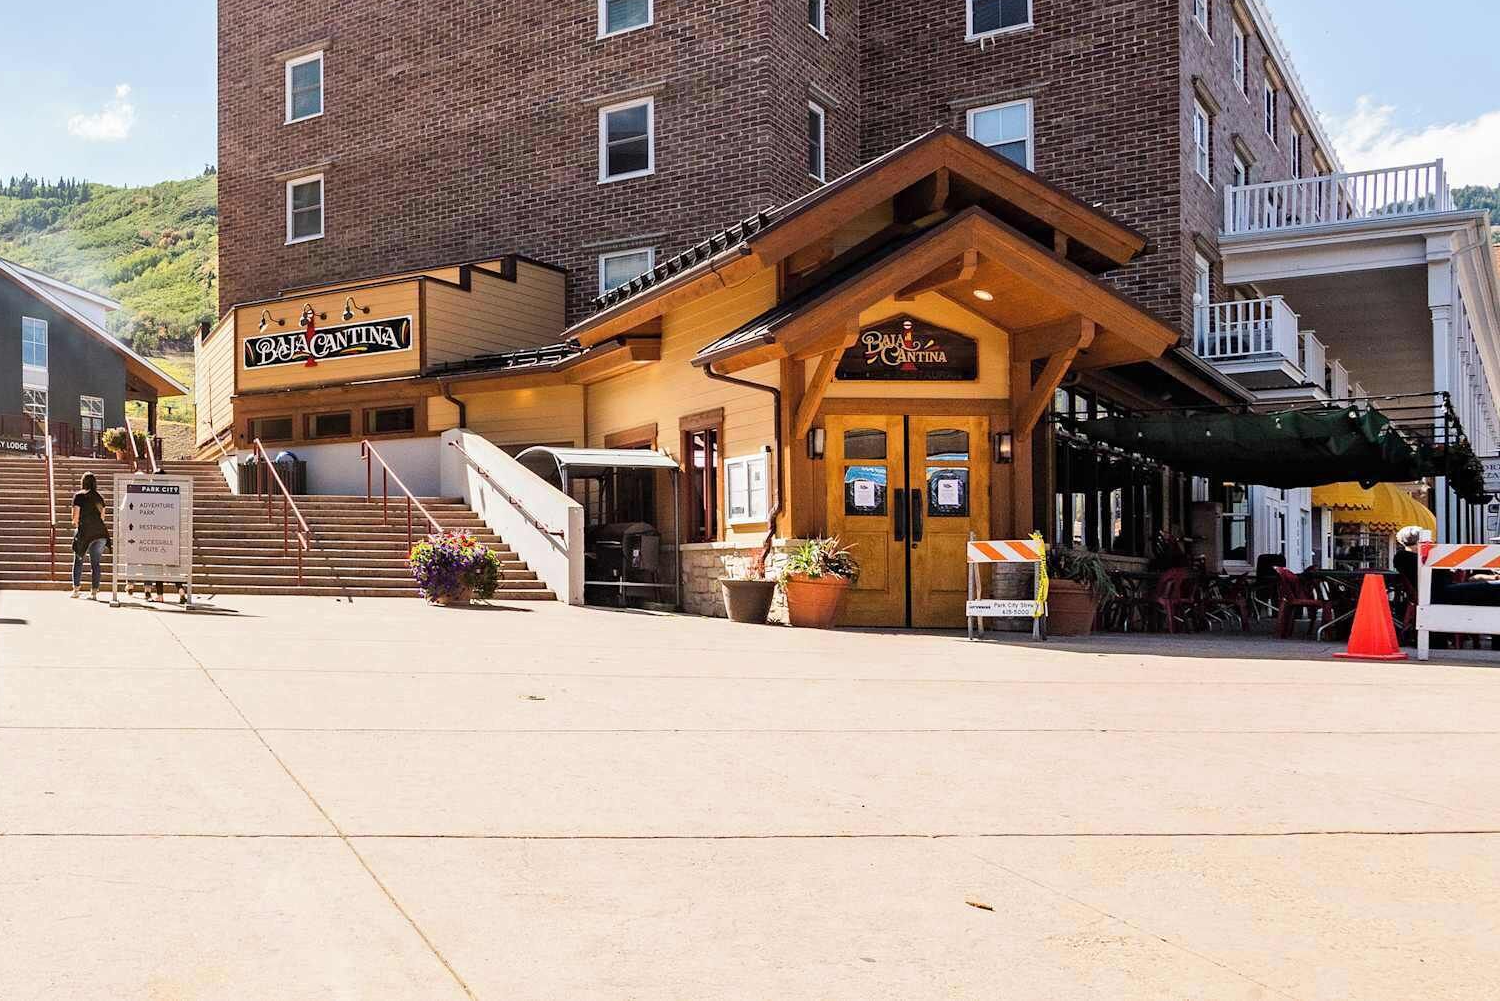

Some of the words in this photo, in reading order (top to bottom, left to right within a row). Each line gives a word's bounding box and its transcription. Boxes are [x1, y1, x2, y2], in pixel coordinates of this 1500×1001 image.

[256, 334, 311, 366] BAJA
[309, 325, 401, 358] CANTINA
[861, 331, 921, 355] BAJA
[881, 344, 947, 366] CANTINA
[6, 441, 28, 451] LODGE
[161, 486, 179, 494] CITY
